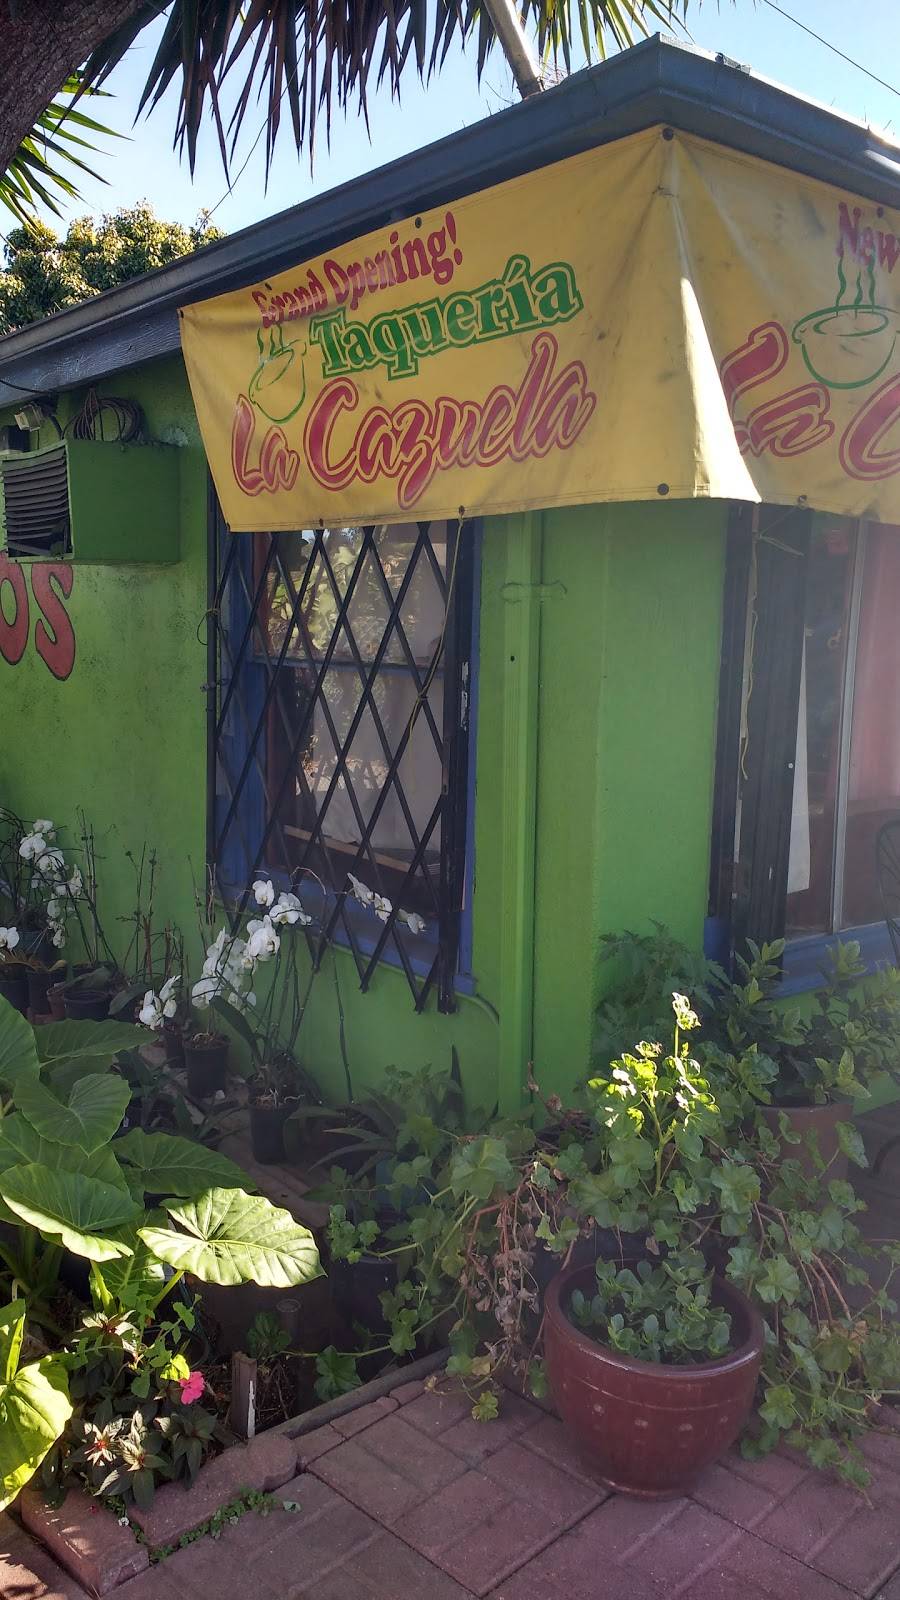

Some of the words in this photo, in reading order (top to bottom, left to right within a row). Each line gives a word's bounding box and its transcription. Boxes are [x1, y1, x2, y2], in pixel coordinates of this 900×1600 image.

[252, 268, 328, 328] Grand
[324, 211, 463, 310] Opening!
[309, 254, 584, 381] Taquería
[231, 394, 300, 497] La
[303, 332, 597, 510] Cazuela
[719, 321, 835, 458] La
